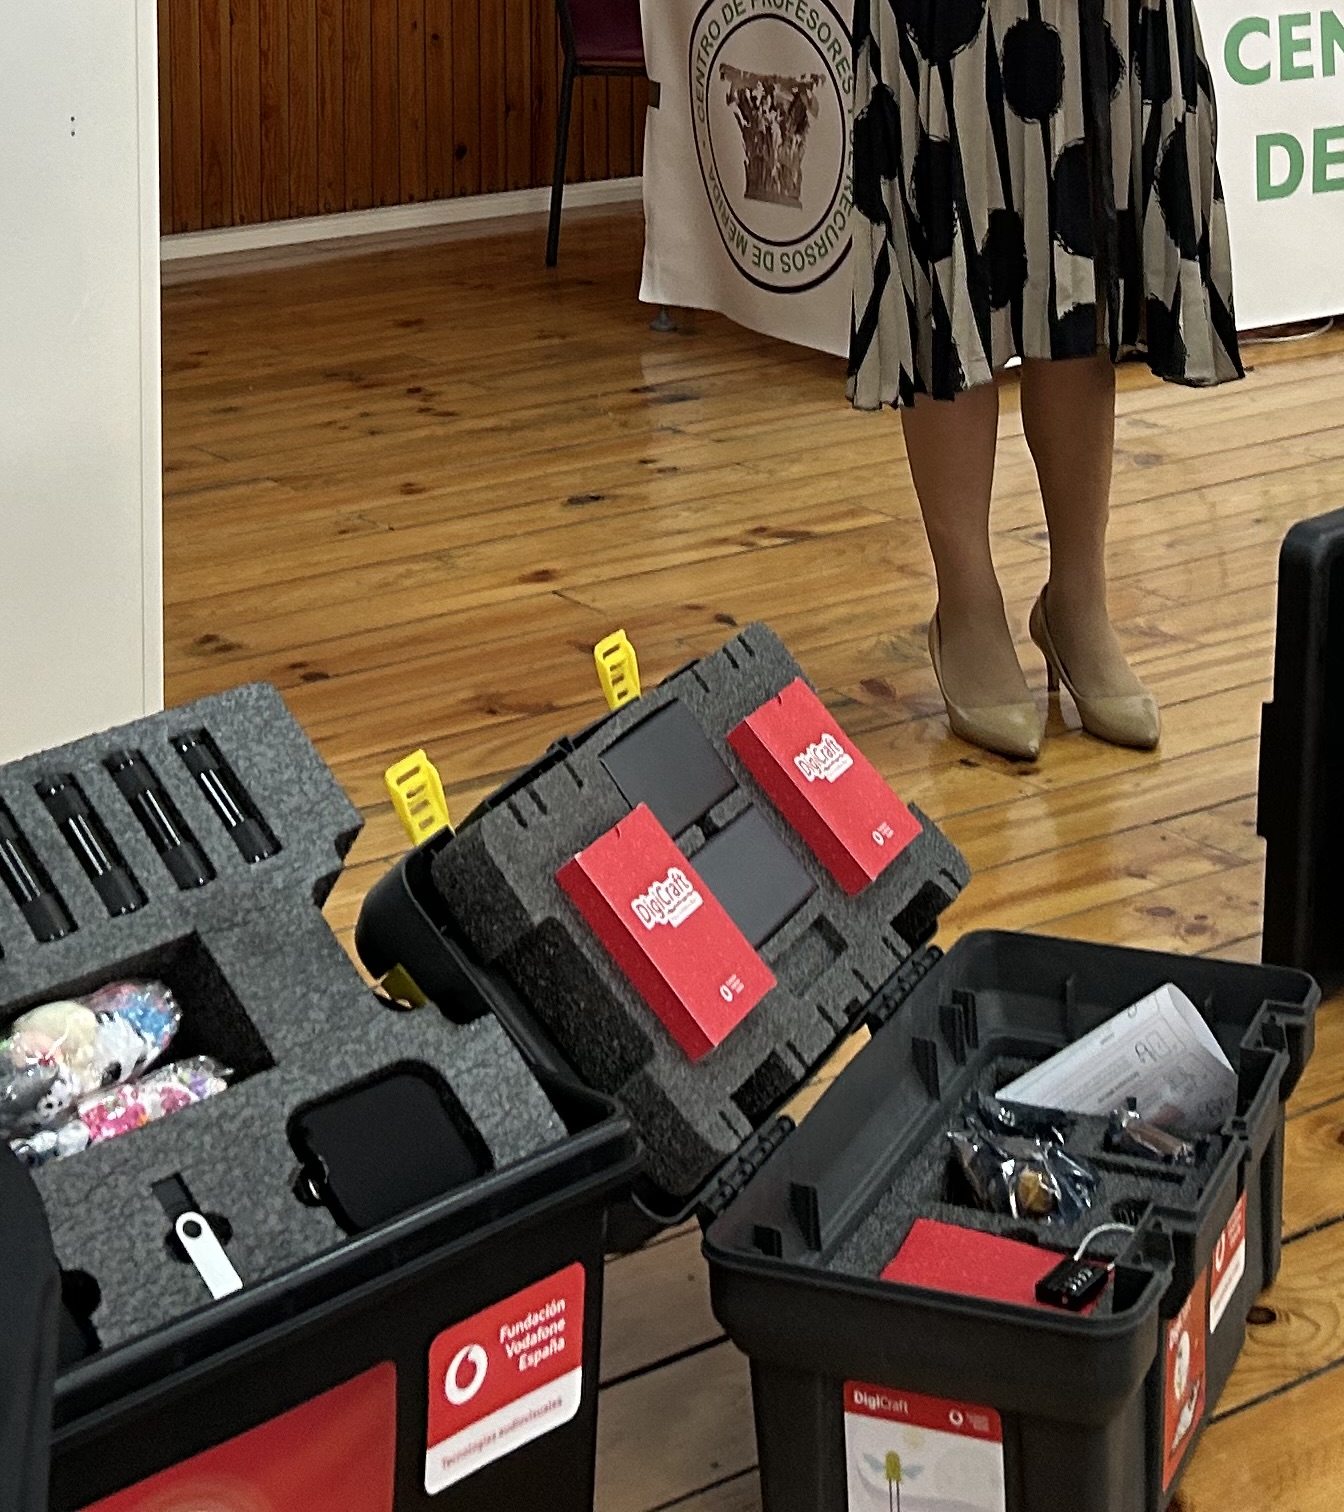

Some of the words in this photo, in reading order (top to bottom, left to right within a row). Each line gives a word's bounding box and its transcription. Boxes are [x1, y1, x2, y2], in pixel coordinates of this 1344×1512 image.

[695, 19, 721, 124] CENTRO
[751, 244, 775, 273] DE
[797, 735, 842, 778] DigiCraft
[635, 871, 691, 925] DigiCraft
[500, 1298, 566, 1345] Fundación
[505, 1317, 566, 1359] Vodafone
[518, 1336, 566, 1373] España
[853, 1389, 909, 1416] DigiCraft
